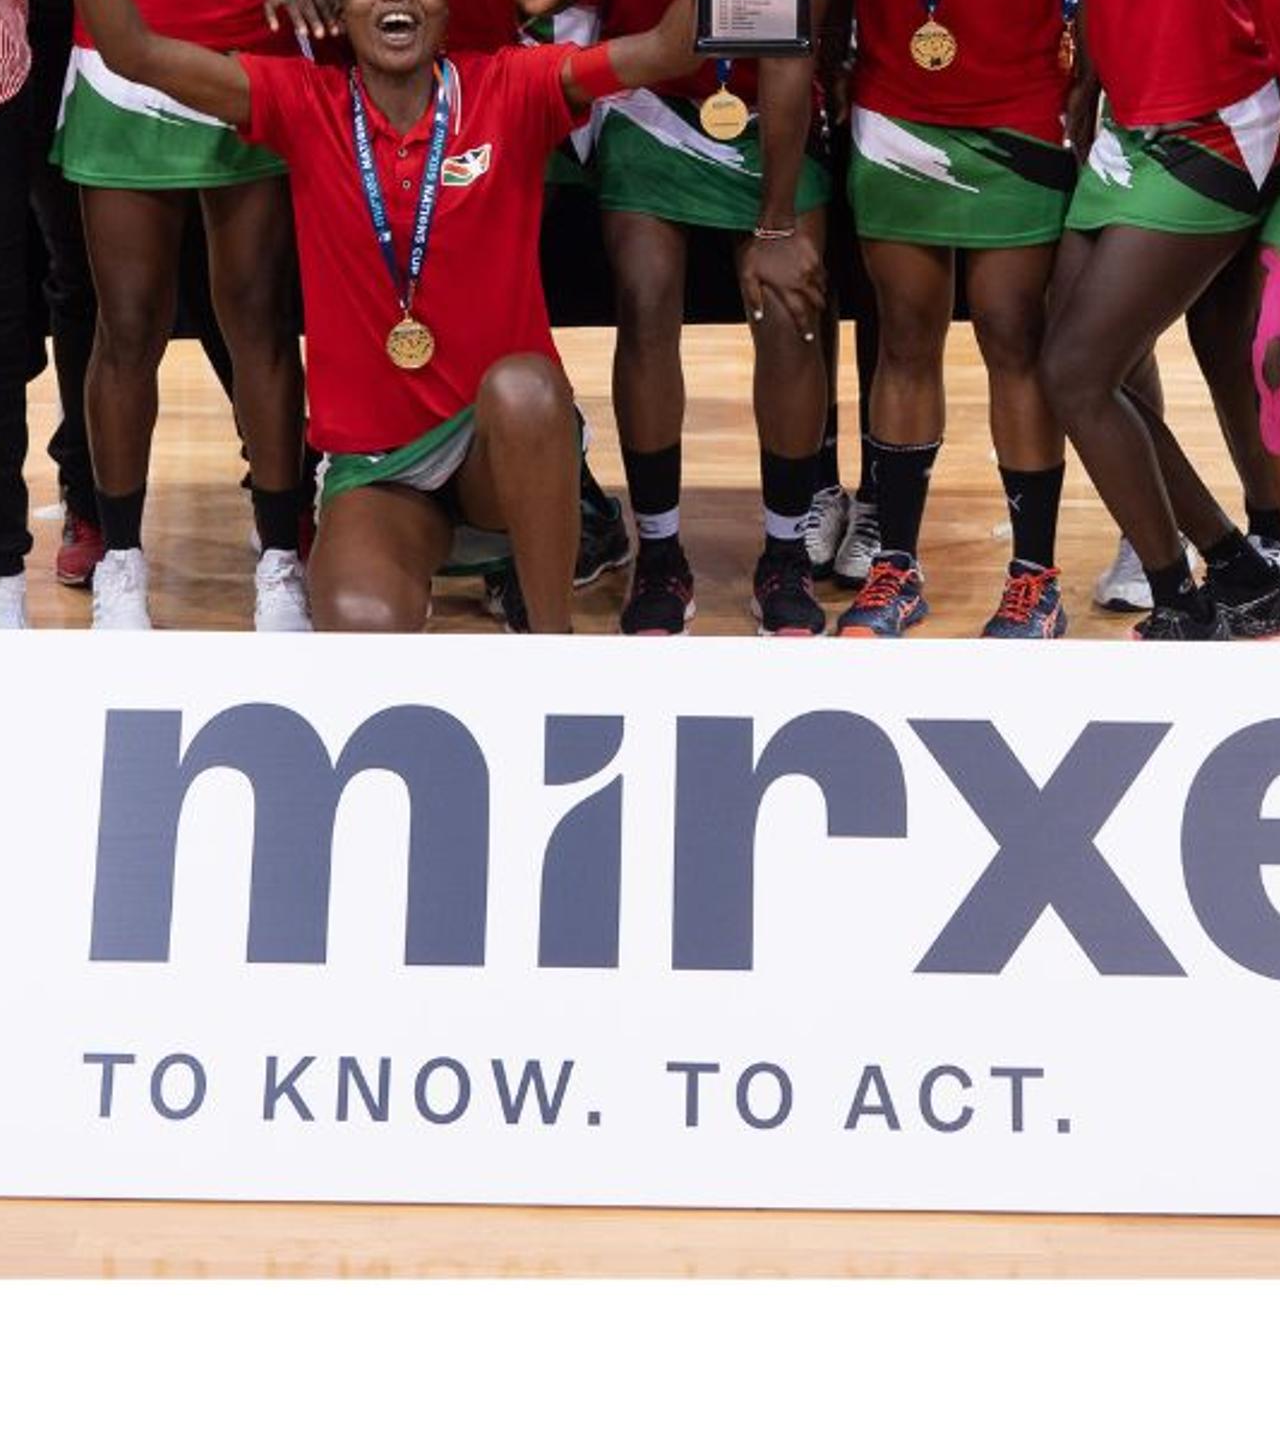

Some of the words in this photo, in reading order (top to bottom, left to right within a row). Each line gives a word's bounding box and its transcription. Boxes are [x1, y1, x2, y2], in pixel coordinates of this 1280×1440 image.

[415, 184, 435, 245] NATIONS
[410, 247, 424, 276] CUP
[83, 1052, 208, 1120] TO
[261, 1054, 602, 1127] KNOW.
[666, 1060, 795, 1130] TO
[842, 1063, 1072, 1135] ACT.
